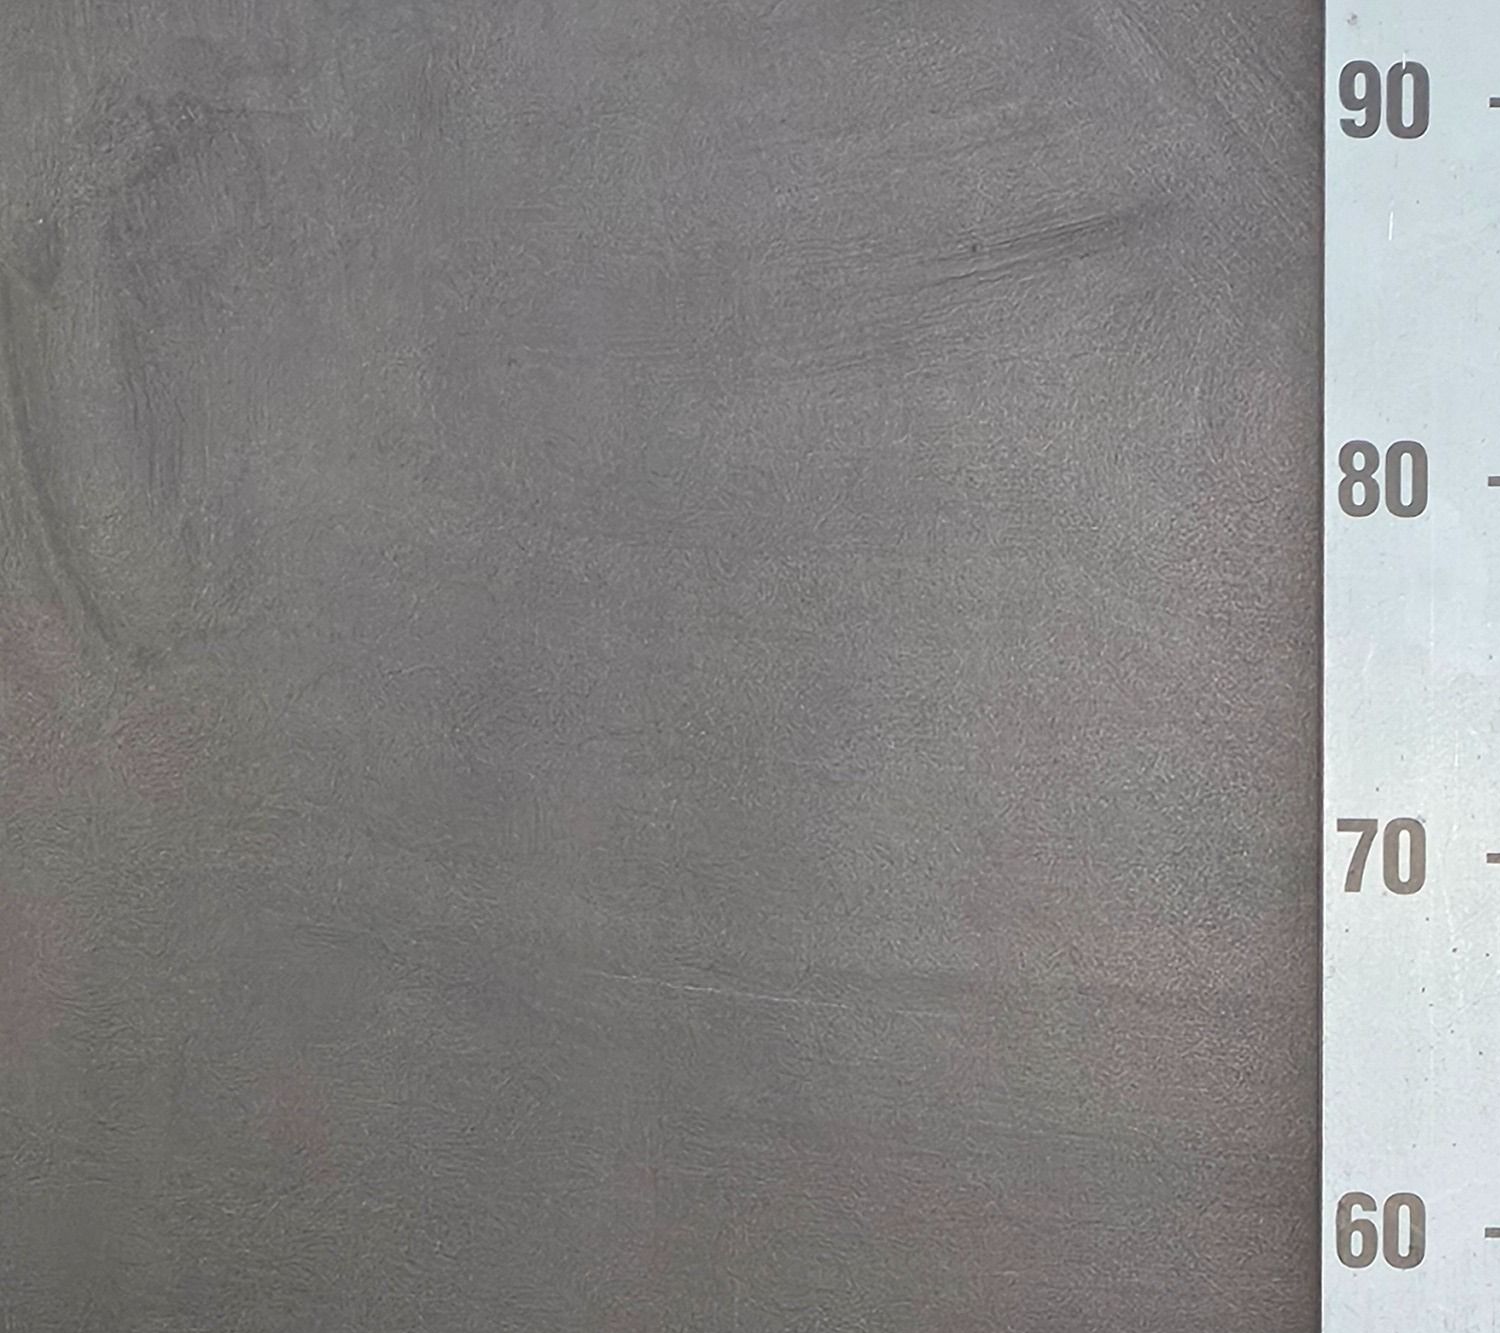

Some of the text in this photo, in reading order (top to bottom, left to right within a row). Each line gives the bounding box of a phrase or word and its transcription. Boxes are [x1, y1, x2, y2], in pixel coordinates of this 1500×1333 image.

[1339, 60, 1429, 139] 90
[1338, 440, 1428, 518] 80
[1337, 818, 1425, 894] 70
[1336, 1192, 1425, 1269] 60
